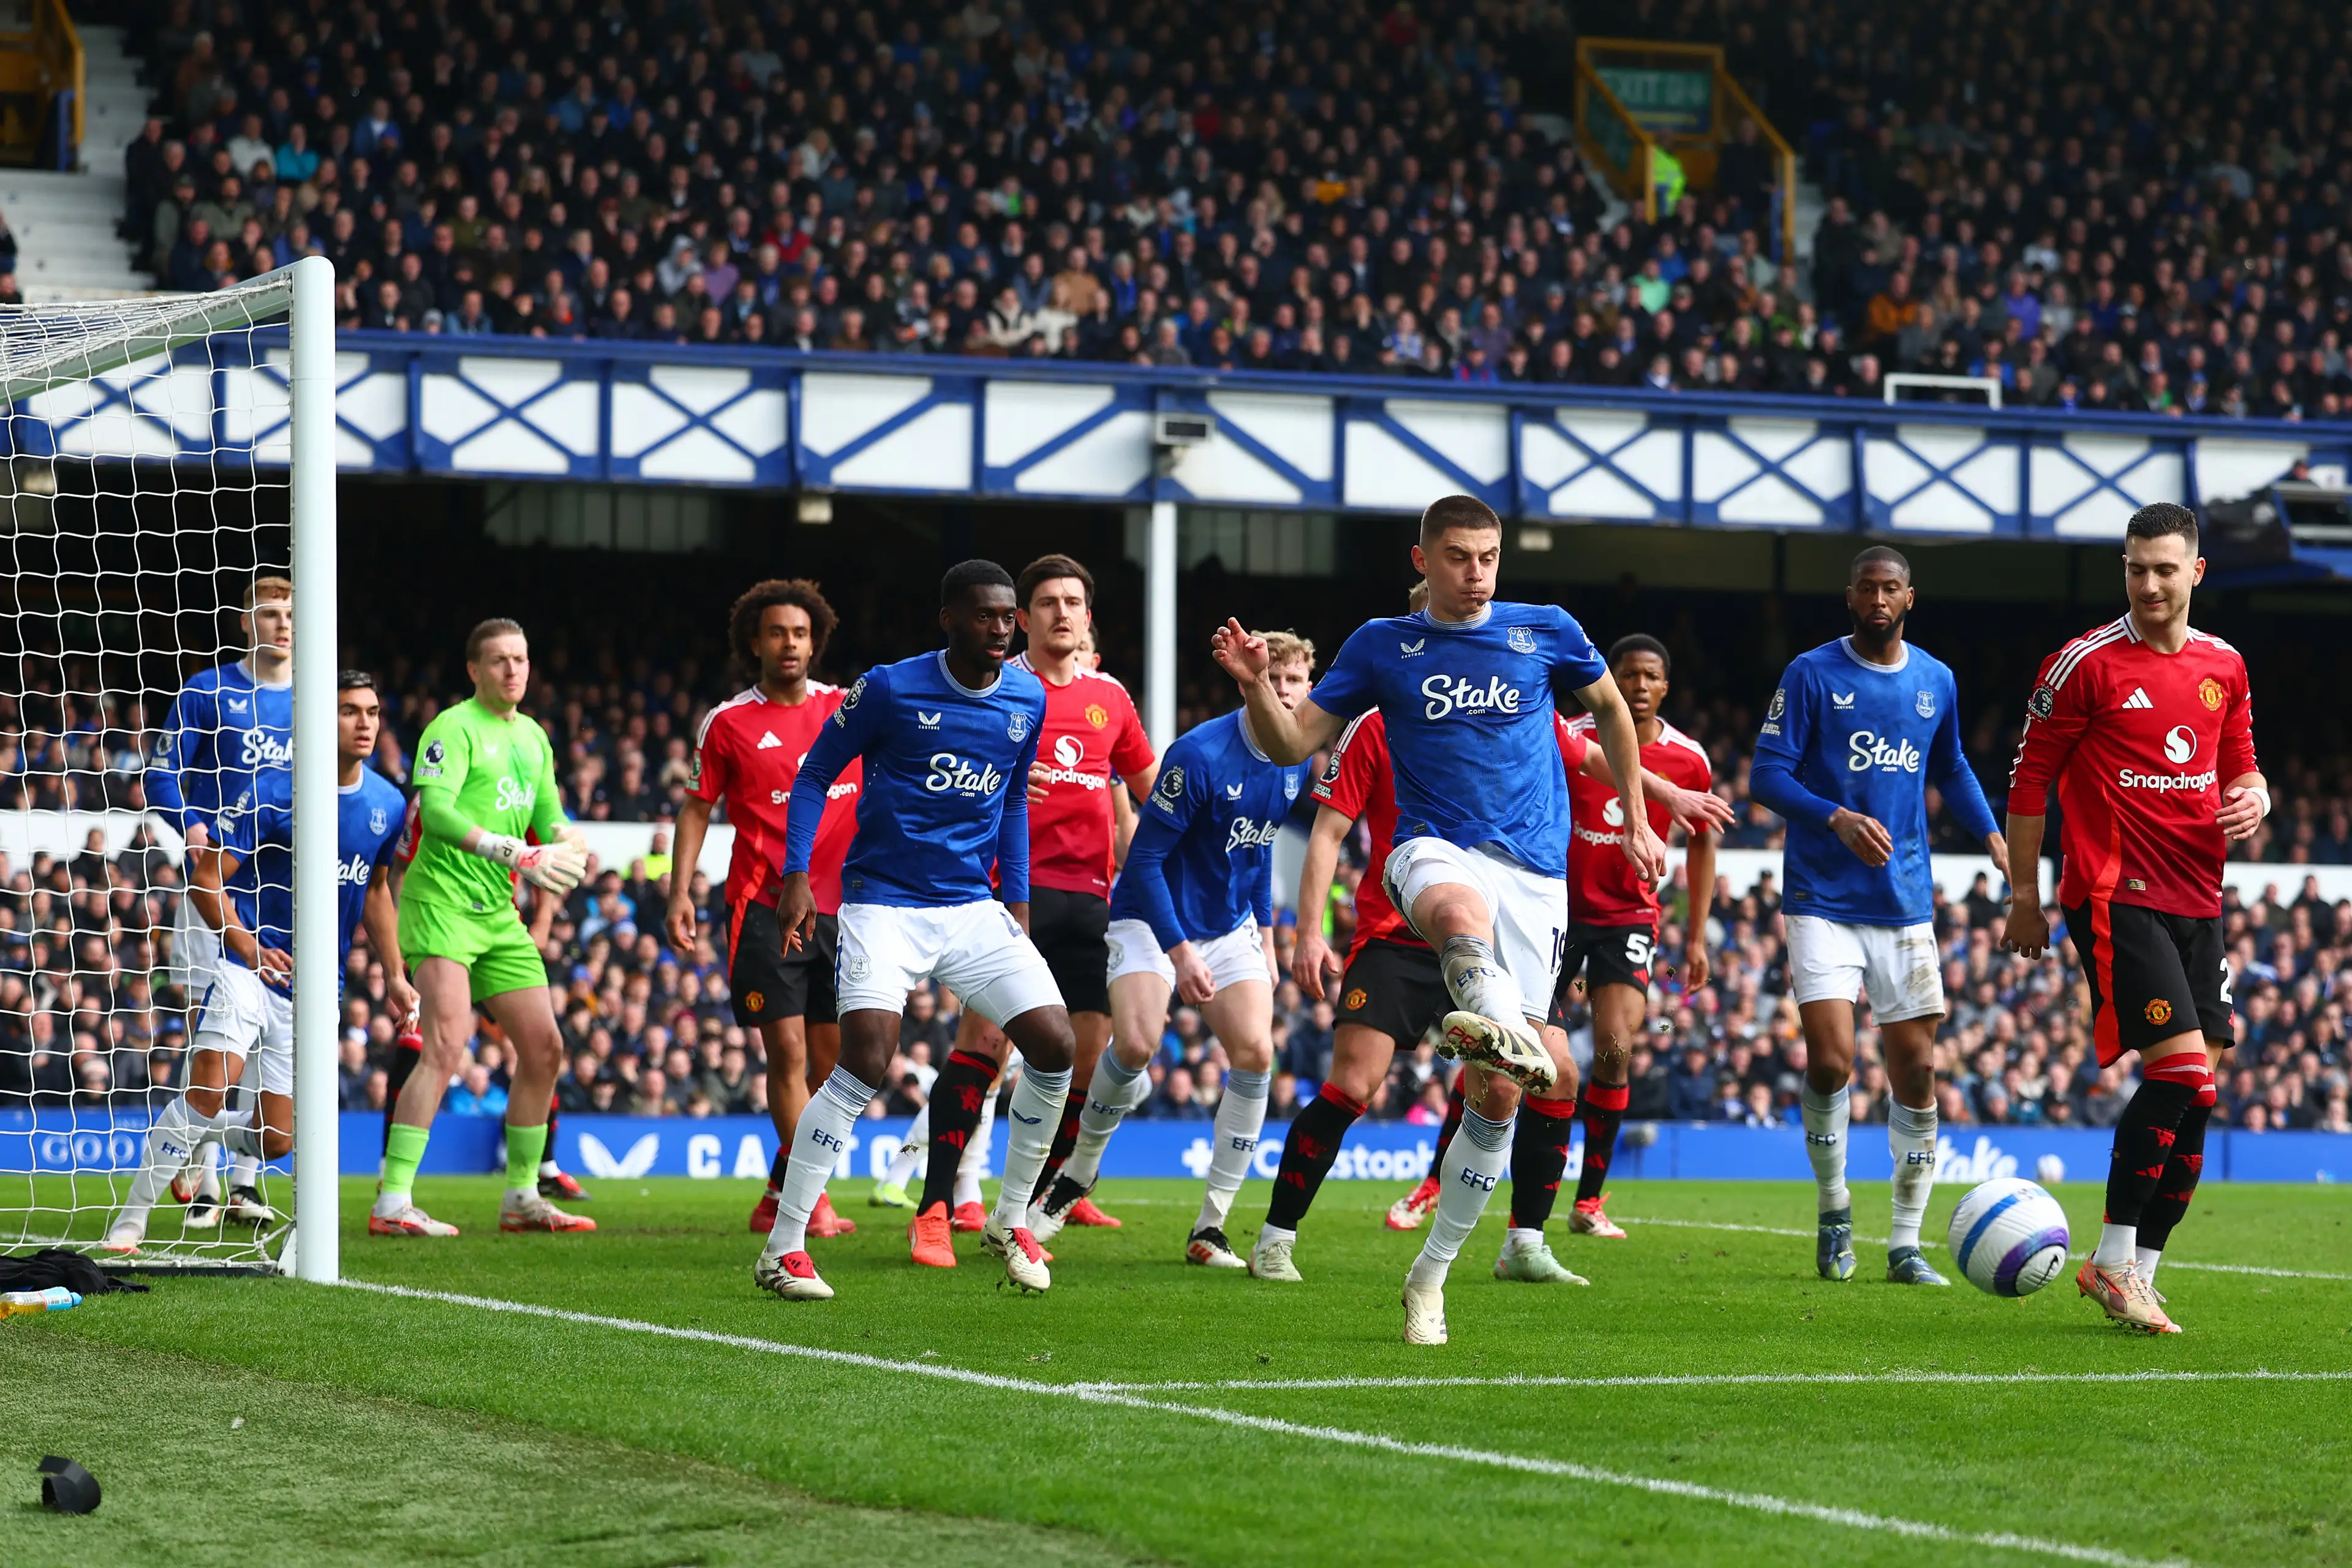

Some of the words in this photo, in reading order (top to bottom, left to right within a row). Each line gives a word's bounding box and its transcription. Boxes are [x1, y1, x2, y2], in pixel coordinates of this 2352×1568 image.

[1422, 674, 1520, 720] Stake
[1849, 731, 1920, 773] Stake
[925, 753, 1001, 796] Stake
[1225, 816, 1278, 853] Stake
[1456, 967, 1496, 988] EFC
[812, 1128, 843, 1153] EFC
[1807, 1131, 1837, 1146] EFC
[1460, 1166, 1496, 1192] EFC
